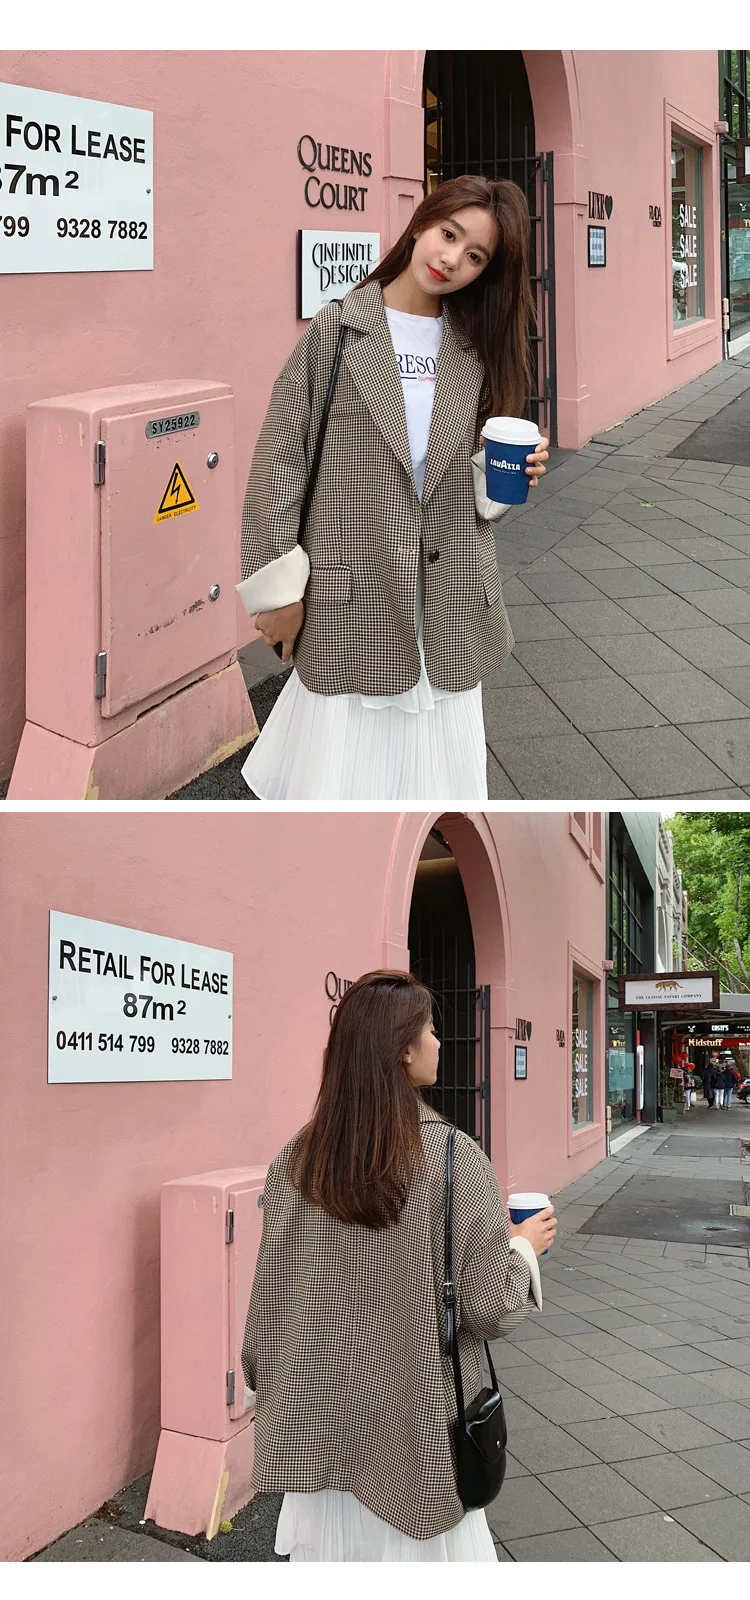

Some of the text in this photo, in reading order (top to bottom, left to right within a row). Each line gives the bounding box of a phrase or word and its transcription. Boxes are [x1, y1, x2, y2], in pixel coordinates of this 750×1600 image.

[6, 114, 146, 164] FOR LEASE
[297, 135, 373, 177] QUEENS
[0, 163, 80, 197] 7m²
[304, 176, 369, 212] COURT
[0, 215, 148, 240] 99 9328 7882
[679, 203, 697, 229] SALE
[311, 242, 373, 269] INFINITE
[680, 234, 697, 258] SALE
[320, 264, 369, 292] DESIGN
[680, 264, 698, 289] SALE
[395, 353, 438, 375] RESO
[151, 414, 196, 435] SY25922
[490, 458, 521, 471] LAVAZZA
[156, 505, 196, 522] DANGER ELECTRICITY
[59, 939, 228, 995] RETAIL FOR LEASE
[56, 1030, 229, 1056] 0411 514 799 9328 7882
[576, 1028, 588, 1048] SALE
[688, 1038, 724, 1047] Kidstuff
[575, 1052, 588, 1073] SALE
[575, 1077, 588, 1099] SALE
